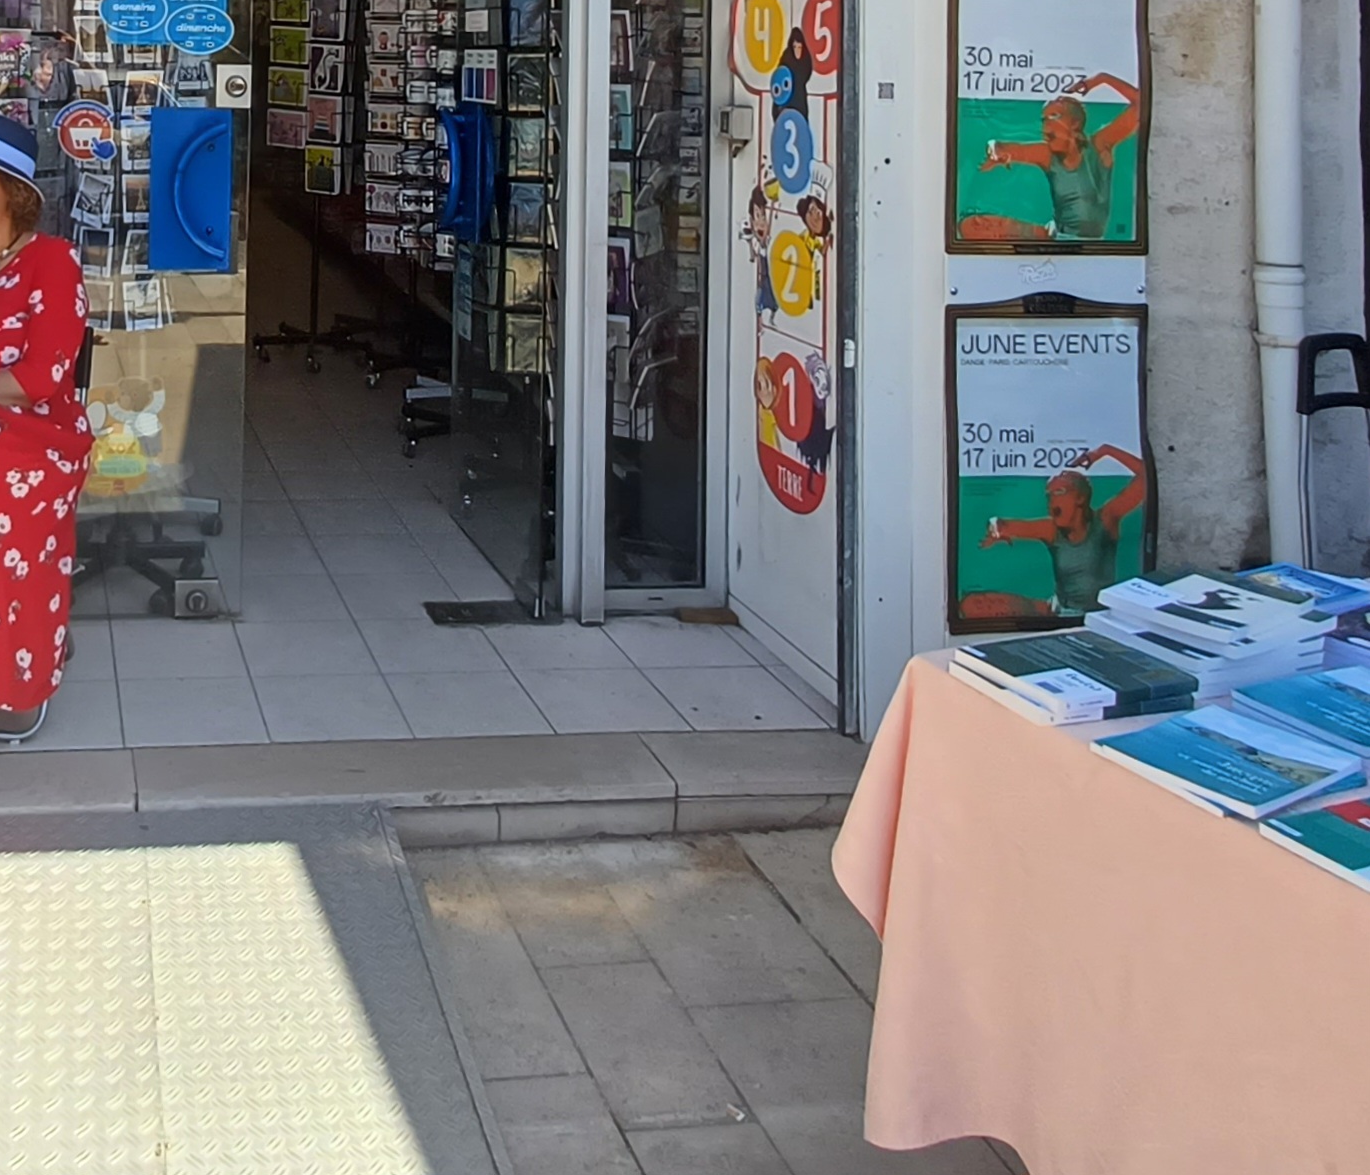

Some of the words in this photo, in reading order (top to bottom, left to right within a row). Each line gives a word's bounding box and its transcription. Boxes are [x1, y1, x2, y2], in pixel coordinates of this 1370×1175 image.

[754, 7, 770, 63] 4
[814, 0, 833, 62] 5
[963, 46, 993, 67] 30
[999, 50, 1033, 68] mai
[963, 71, 984, 91] 17
[991, 73, 1025, 96] juin
[1030, 72, 1088, 96] 2023
[783, 119, 800, 180] 3
[781, 245, 799, 304] 2
[961, 334, 1026, 355] JUNE
[1033, 334, 1131, 355] EVENTS
[782, 366, 797, 428] 1
[962, 422, 993, 444] 30
[999, 425, 1034, 444] mai
[962, 447, 984, 469] 17
[991, 449, 1026, 473] juin
[1033, 447, 1091, 471] 2023
[776, 464, 803, 503] TERRE
